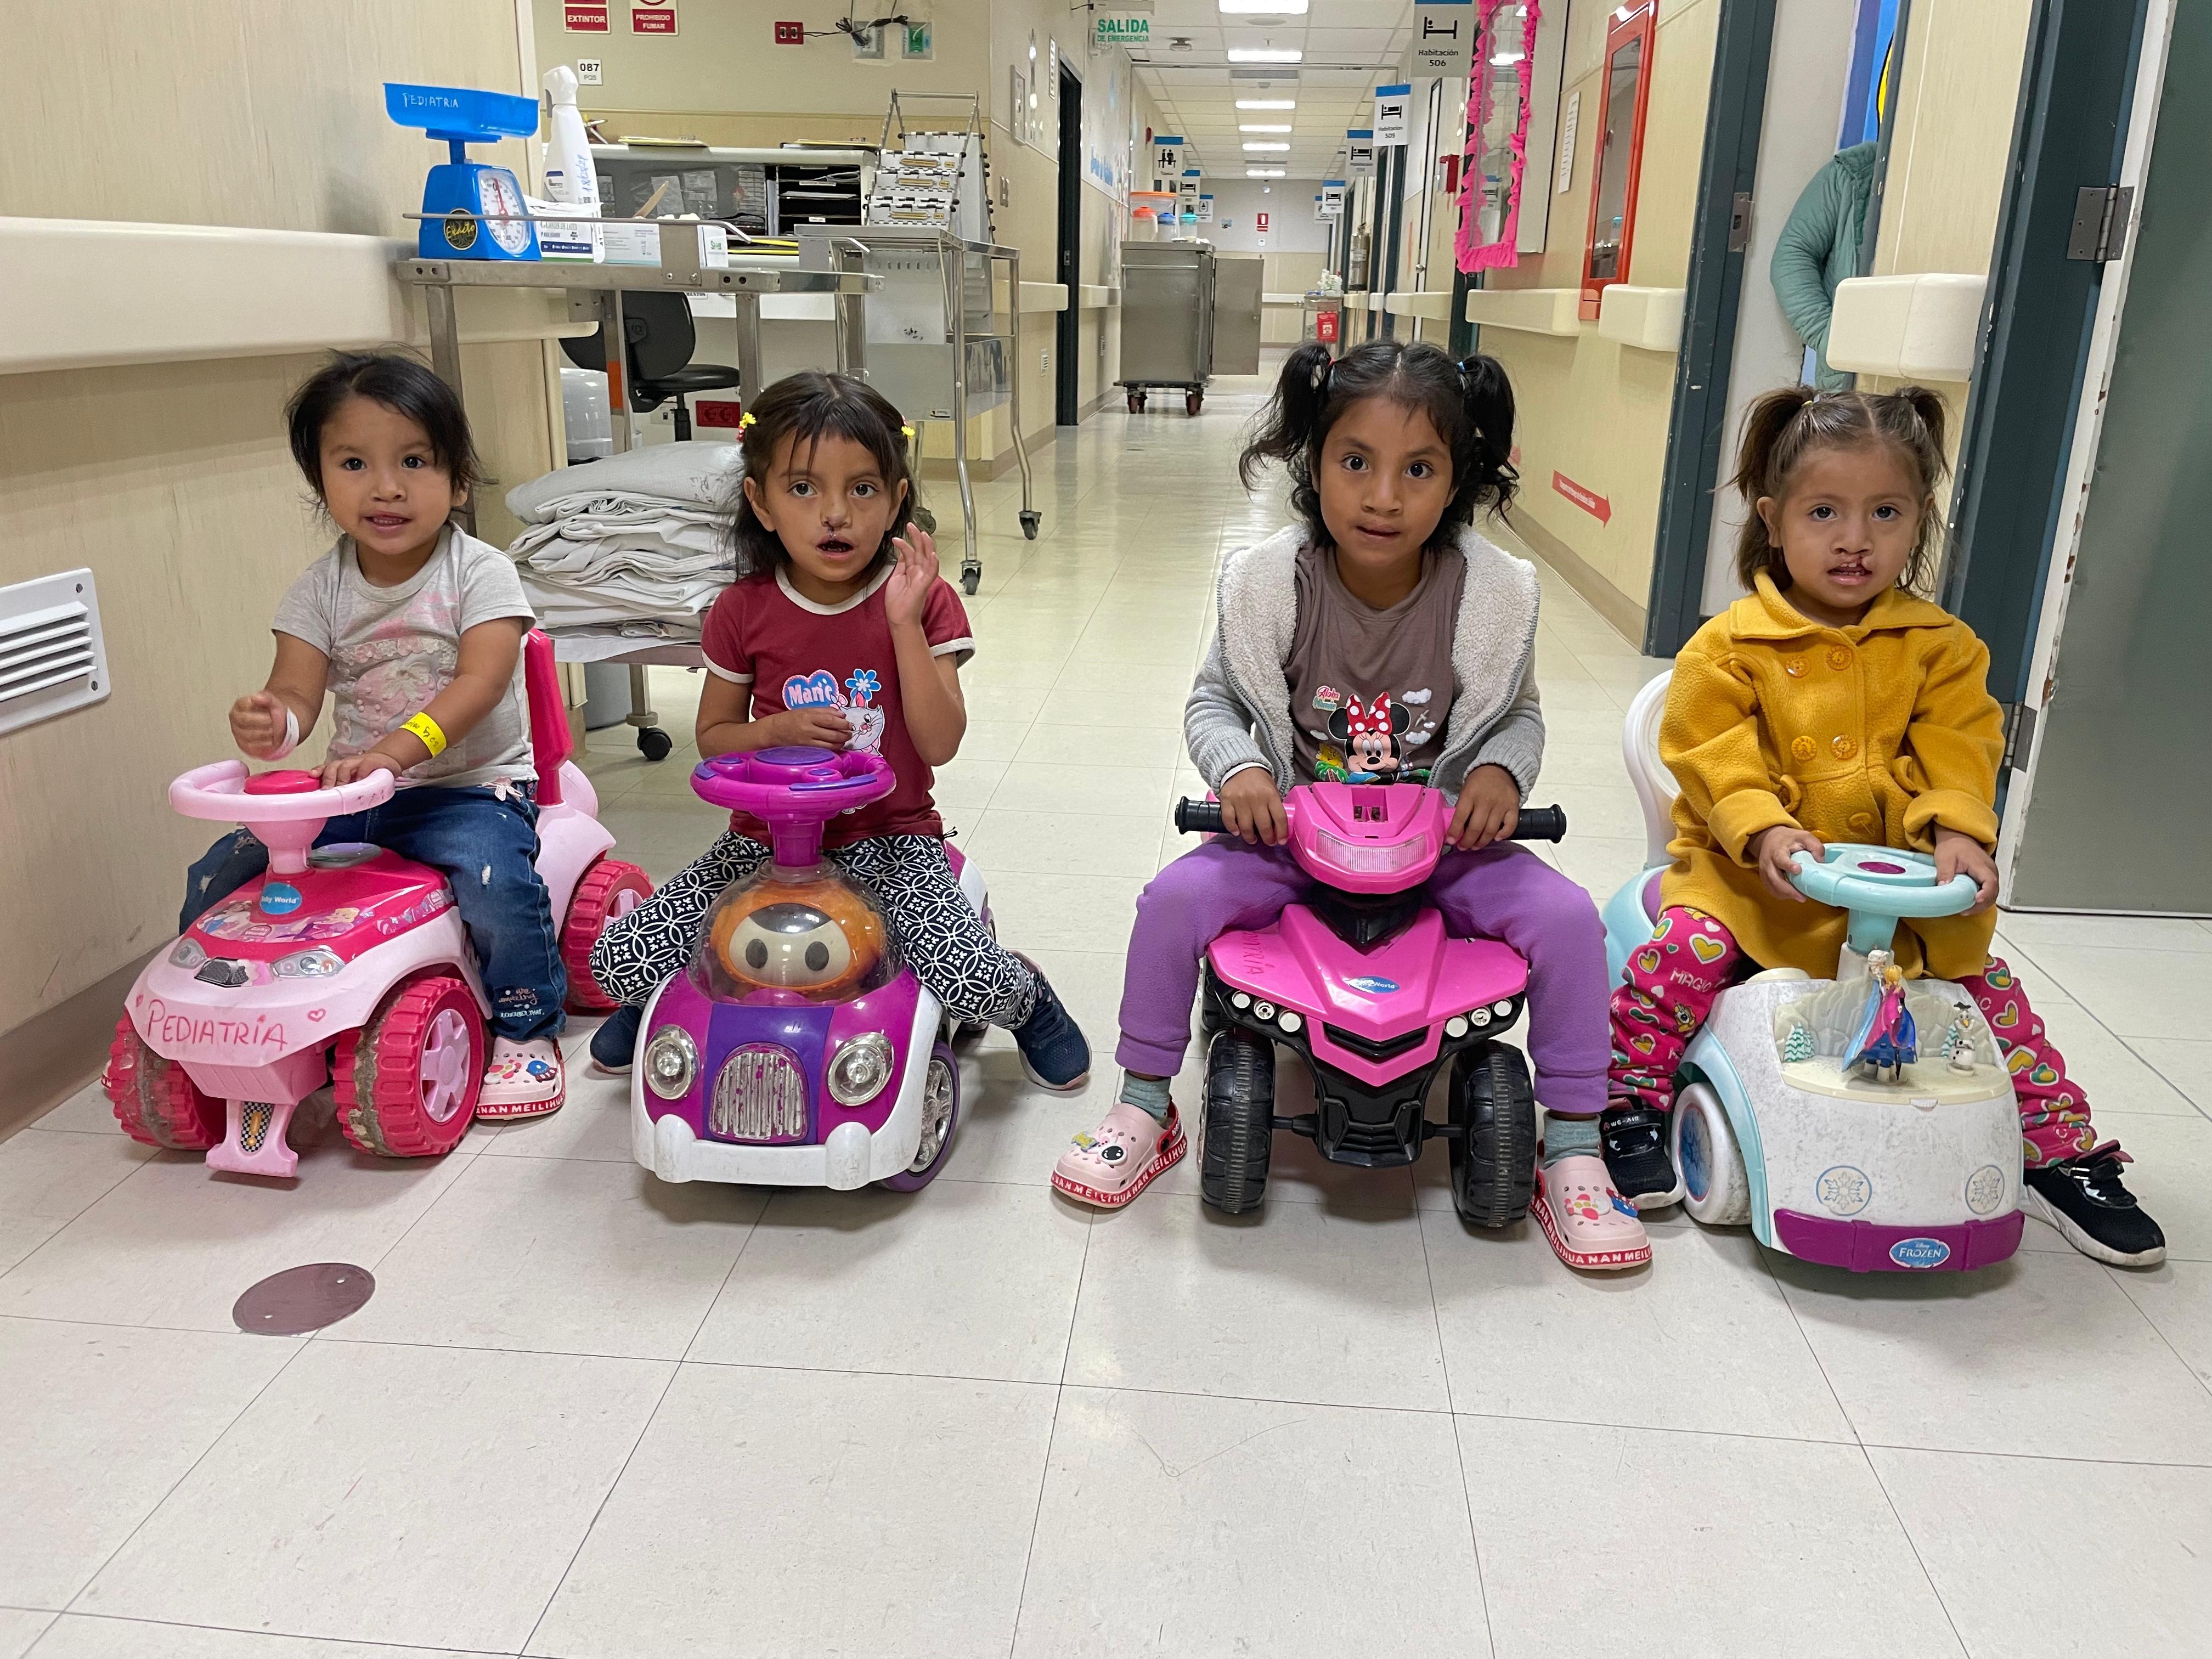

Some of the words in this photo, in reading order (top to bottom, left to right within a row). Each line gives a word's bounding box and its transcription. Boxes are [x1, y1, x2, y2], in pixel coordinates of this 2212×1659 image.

[567, 15, 606, 23] EXTINTOR
[1098, 19, 1149, 32] SALIDA
[580, 63, 599, 71] 087
[403, 92, 459, 108] PEDIATRIA
[788, 678, 833, 706] Marie
[1670, 968, 1712, 992] MAGIC
[1899, 1248, 1942, 1258] FROZEN
